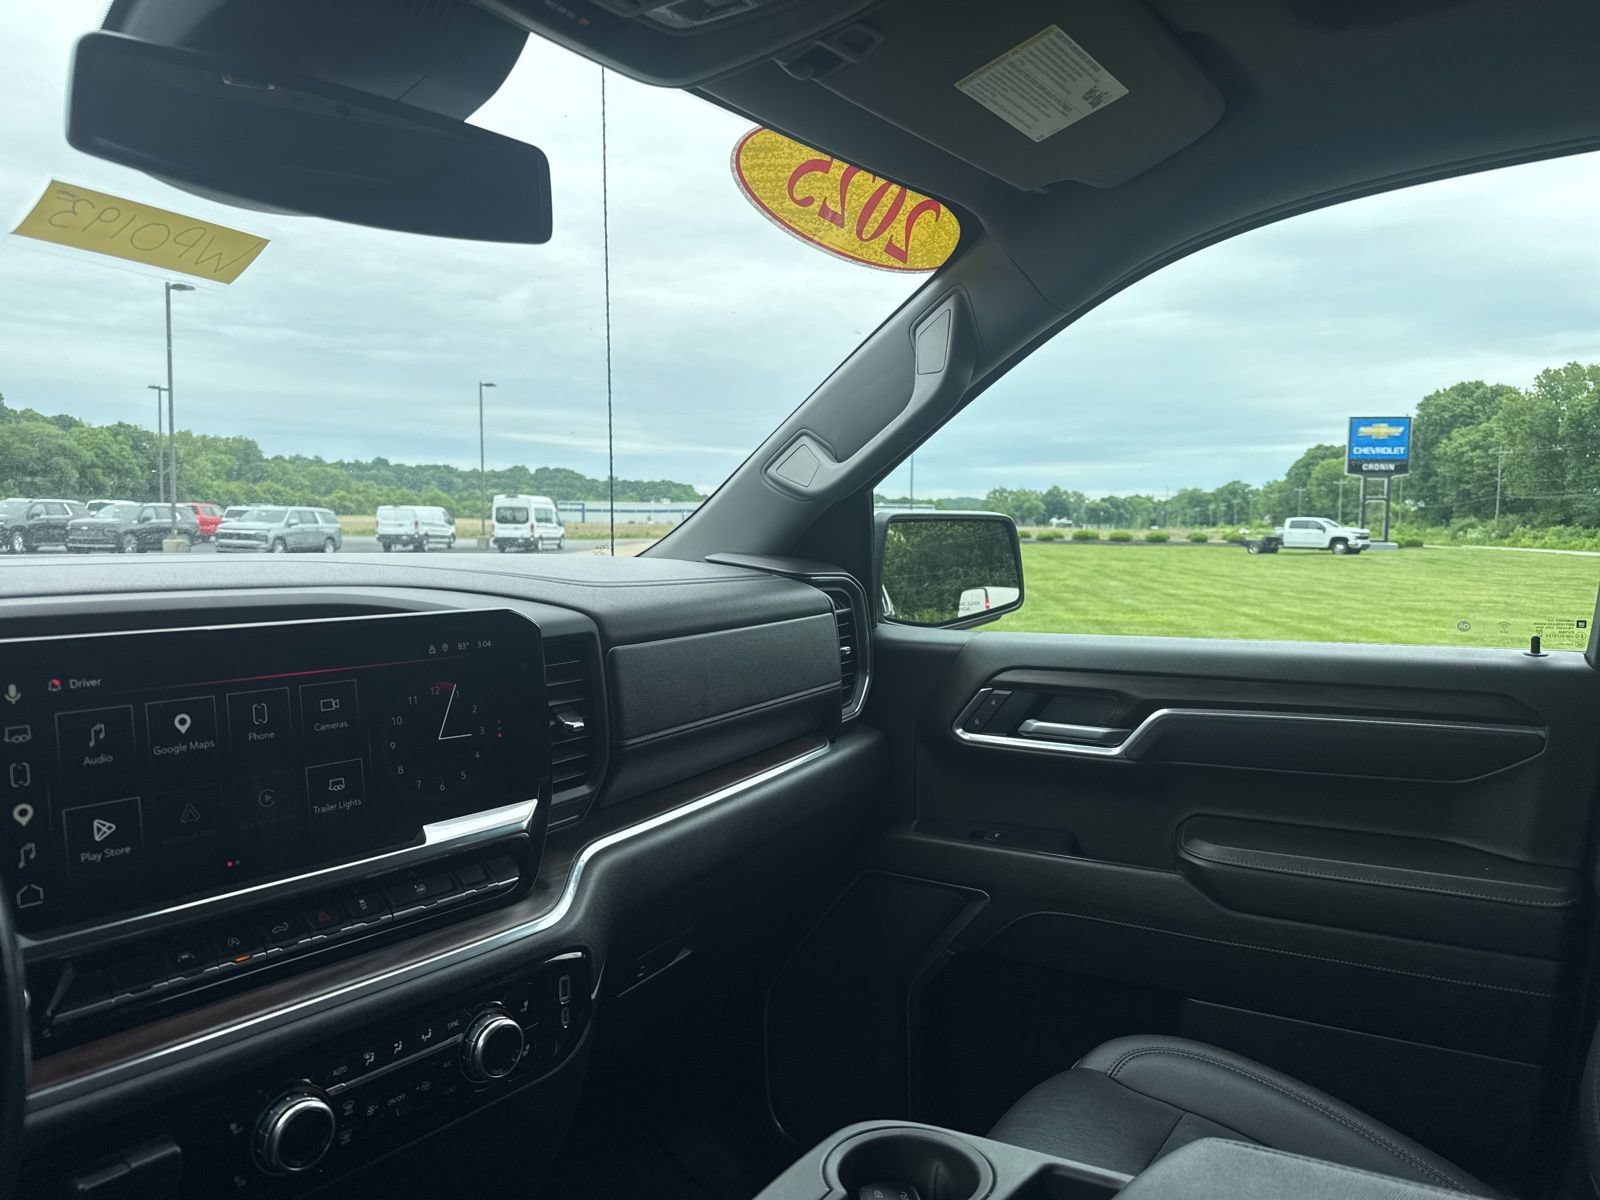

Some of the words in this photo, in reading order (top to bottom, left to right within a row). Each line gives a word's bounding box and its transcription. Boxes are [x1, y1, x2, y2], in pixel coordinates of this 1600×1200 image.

[1353, 446, 1406, 454] CHEVROLET
[1362, 463, 1395, 471] CRONIN
[69, 677, 102, 689] Driver
[430, 686, 439, 695] 12
[408, 695, 417, 705] 11
[471, 704, 478, 713] 2
[391, 716, 402, 726] 10
[314, 721, 348, 732] Cameras
[479, 726, 485, 735] 3
[248, 732, 275, 742] Phone
[153, 742, 187, 757] Google
[189, 740, 215, 754] Maps
[390, 741, 397, 751] 9
[474, 750, 481, 759] 4
[83, 754, 114, 766] Audio
[397, 765, 405, 775] 8
[460, 770, 467, 780] 5
[416, 779, 422, 789] 7
[440, 782, 446, 791] 6
[313, 802, 337, 814] Trailer
[338, 799, 361, 812] Lights
[80, 851, 102, 864] Play
[104, 846, 131, 859] Store
